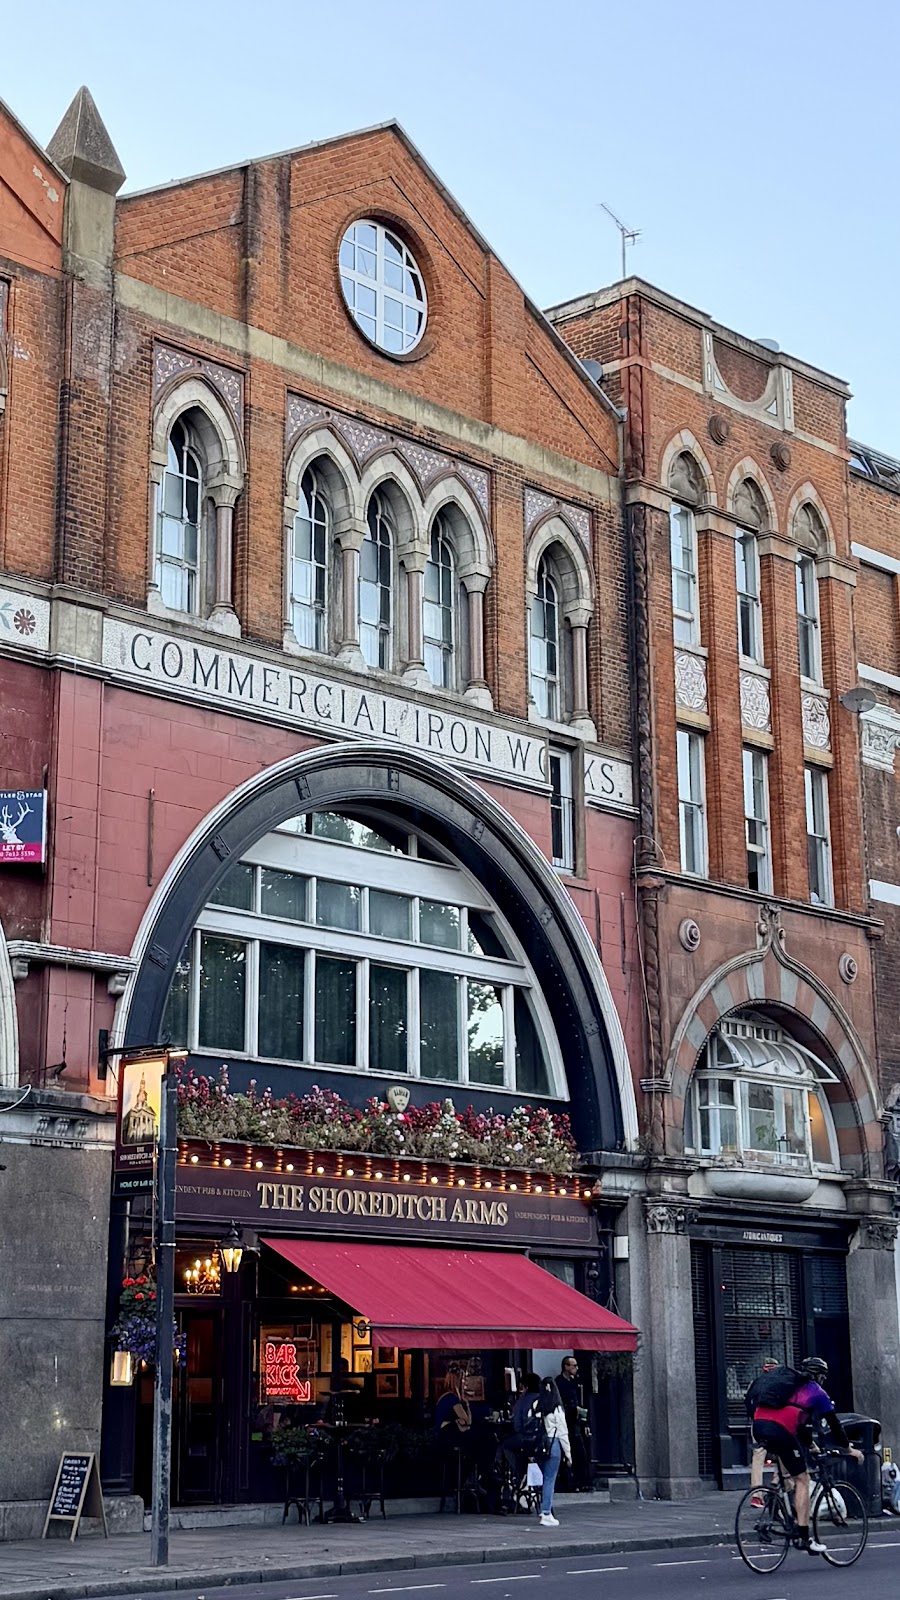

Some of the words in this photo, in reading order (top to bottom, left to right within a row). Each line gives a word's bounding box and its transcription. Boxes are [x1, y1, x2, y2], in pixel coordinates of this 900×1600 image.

[131, 633, 399, 737] COMMERCIAL
[415, 709, 492, 763] IRON
[506, 735, 624, 798] WKS.
[17, 791, 25, 800] &
[174, 1185, 201, 1194] ENDENT
[202, 1186, 216, 1195] PUB
[216, 1188, 222, 1196] &
[222, 1188, 252, 1198] KITCHEN
[257, 1182, 304, 1212] THE
[308, 1186, 448, 1222] SHOREDITCH
[450, 1198, 509, 1227] ARMS
[265, 1343, 297, 1364] BAR
[266, 1365, 300, 1386] KICK
